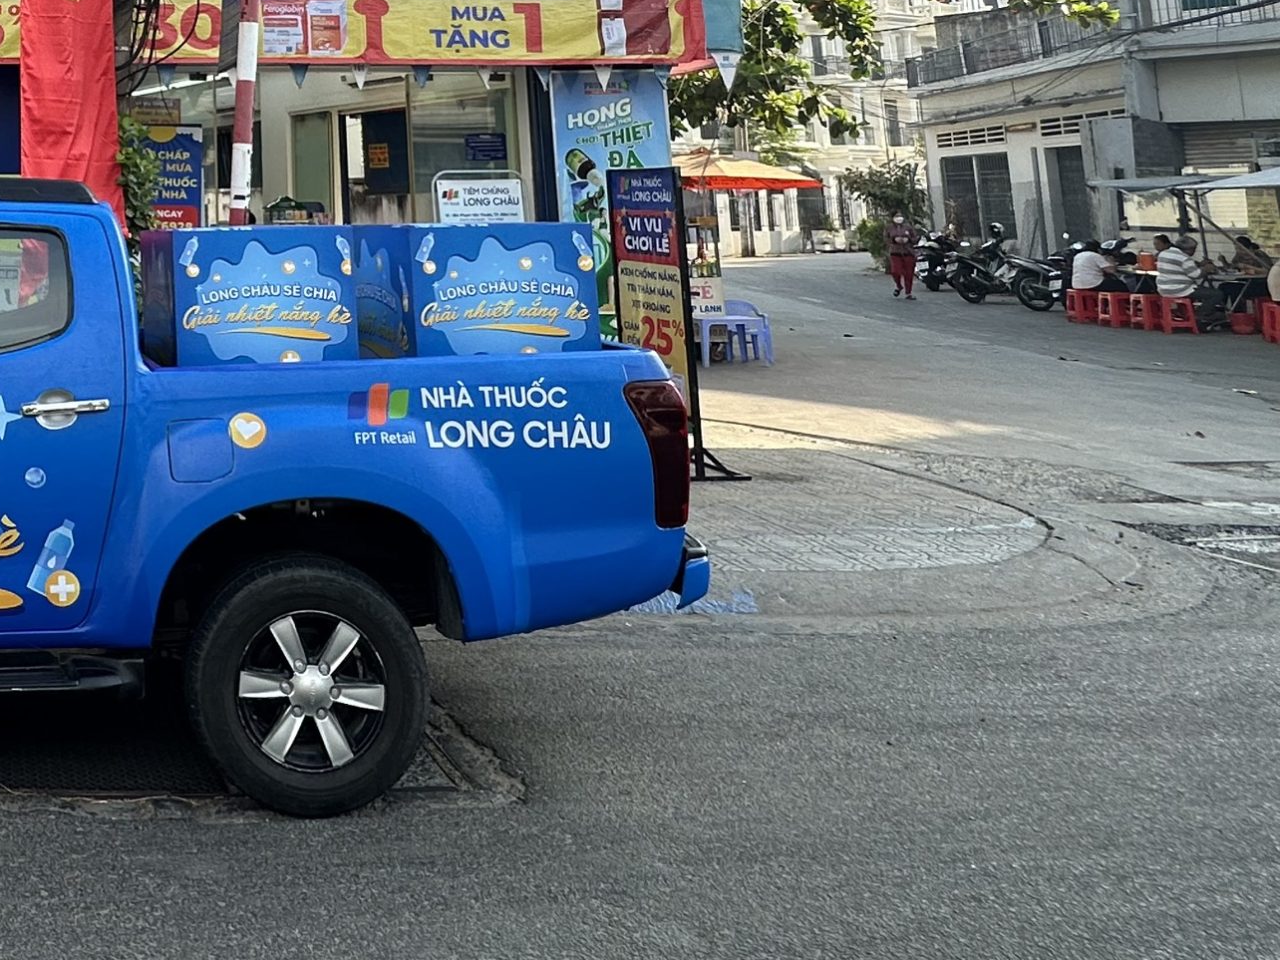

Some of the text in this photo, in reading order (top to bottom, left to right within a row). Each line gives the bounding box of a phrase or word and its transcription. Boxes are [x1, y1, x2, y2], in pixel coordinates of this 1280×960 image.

[450, 5, 506, 22] MUA
[429, 2, 543, 54] TẶNG 1
[566, 97, 632, 130] HỌNG
[463, 196, 491, 207] LONG
[493, 195, 520, 206] CHÂU
[631, 191, 651, 203] LONG
[651, 189, 672, 203] CHÂU
[628, 217, 662, 233] VI VU
[624, 235, 653, 252] CHƠI
[202, 286, 239, 304] LONG
[241, 282, 280, 297] CHÂU
[303, 286, 338, 302] CHIA
[439, 284, 476, 302] LONG
[479, 279, 518, 294] CHÂU
[541, 283, 575, 298] CHIA
[183, 300, 352, 330] Giải nhiệt nắng hè
[420, 296, 591, 327] Giải nhiệt nắng hè
[641, 315, 685, 356] 25%
[420, 377, 568, 409] NHÀ THUỐC
[354, 430, 416, 445] FPT Retail
[425, 413, 611, 449] LONG CHÂU
